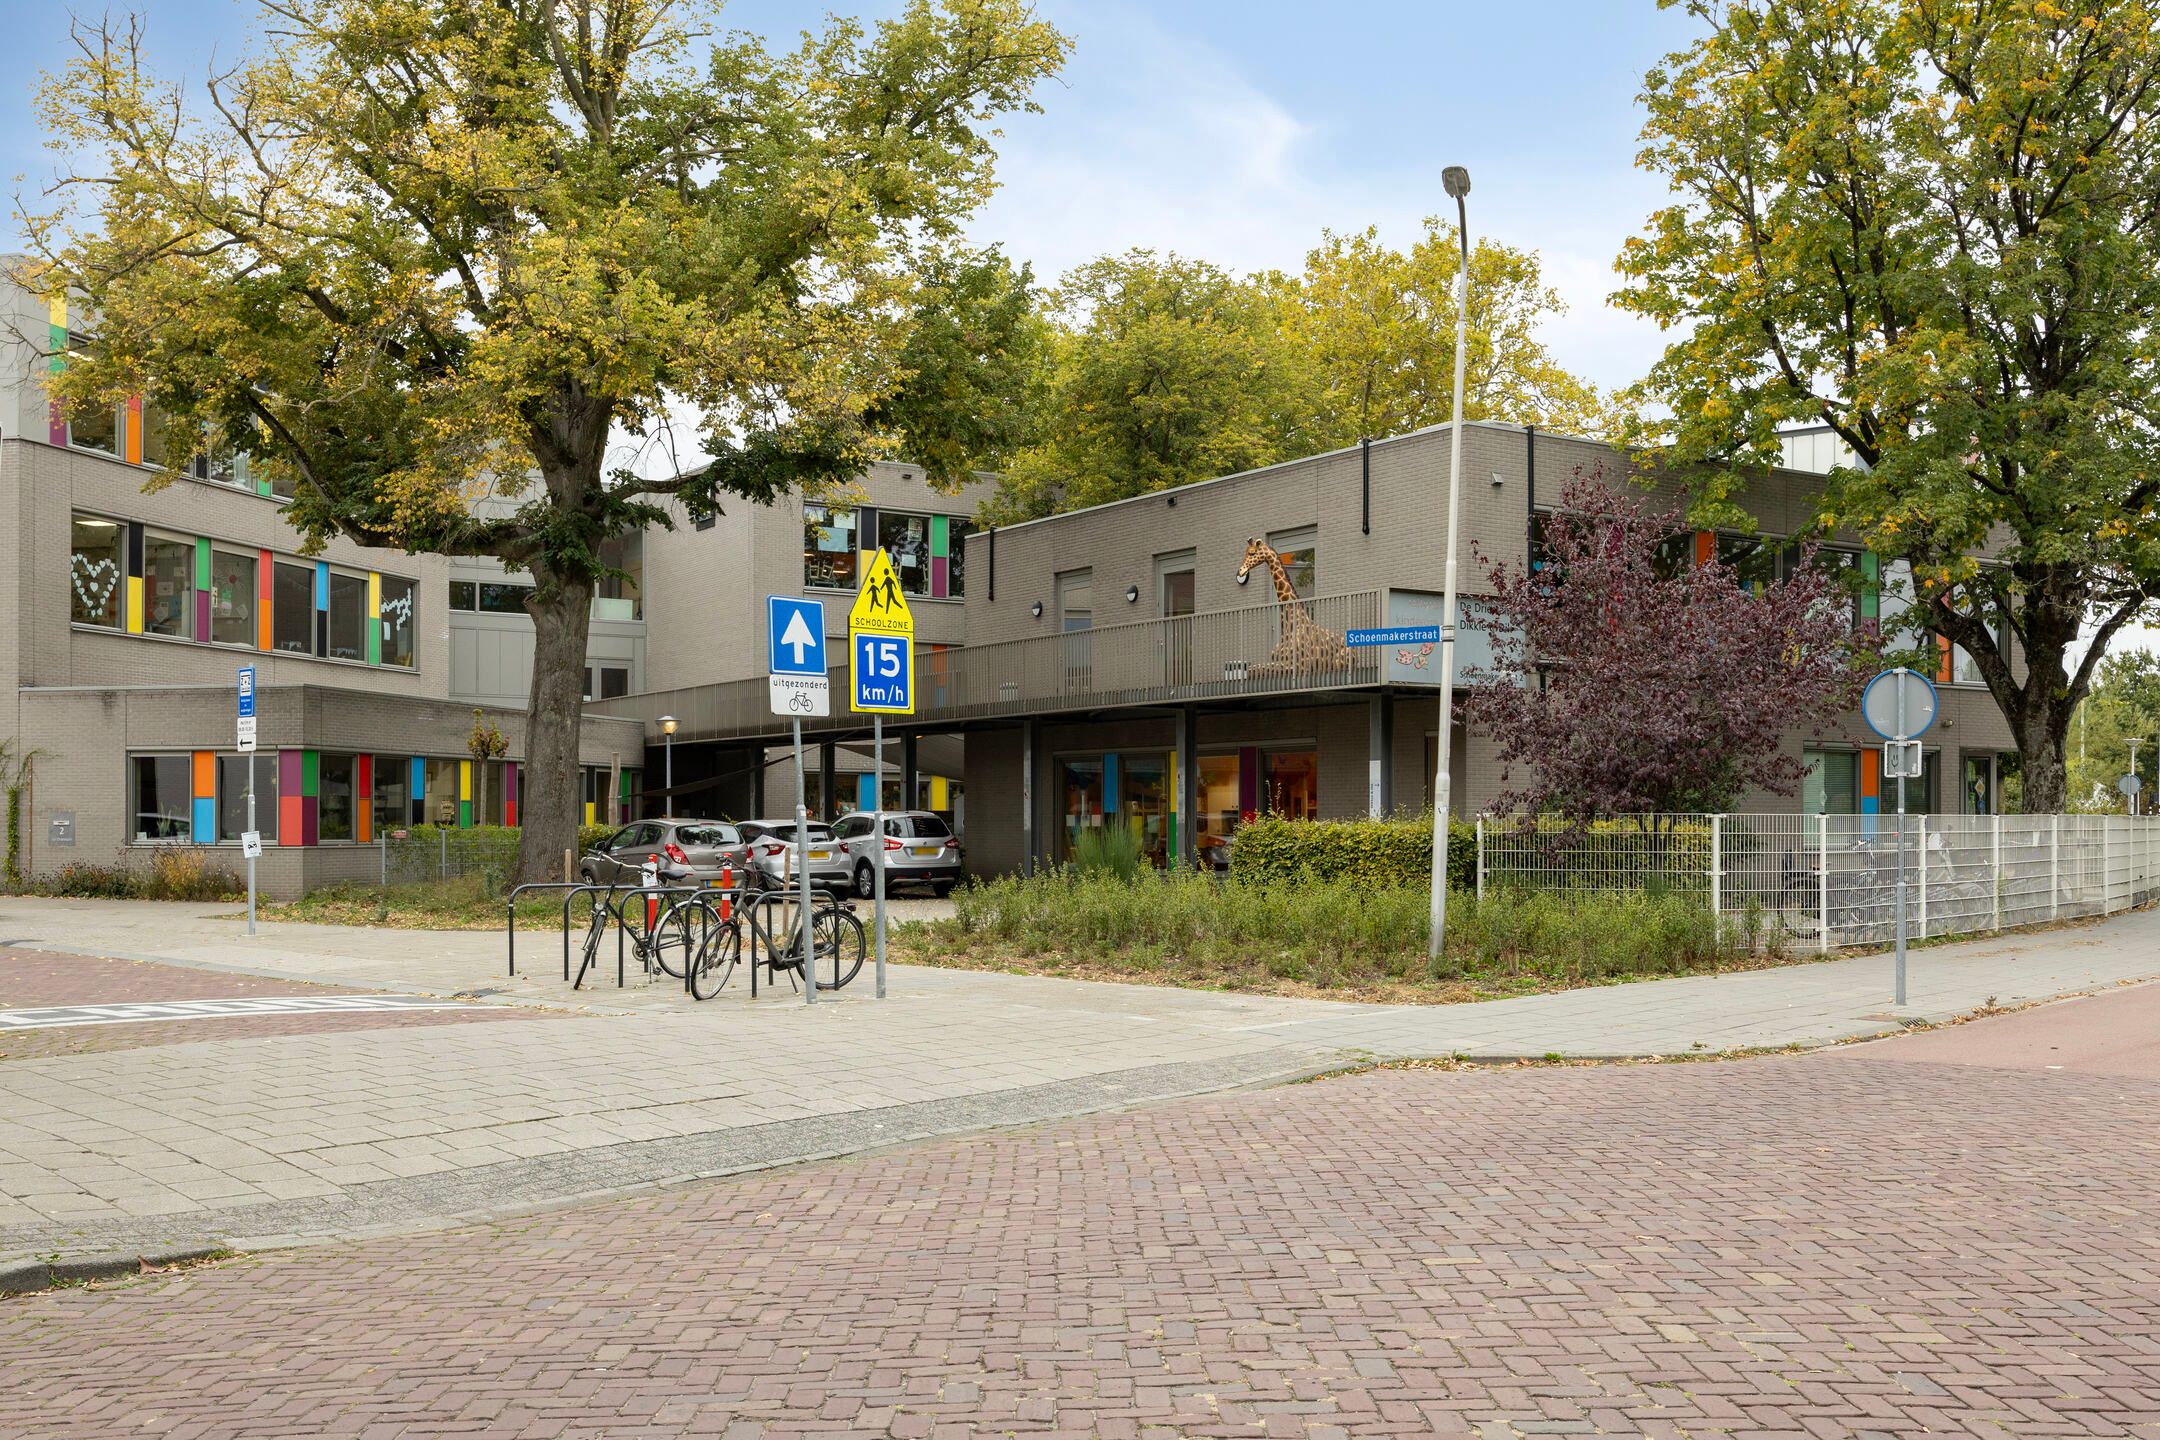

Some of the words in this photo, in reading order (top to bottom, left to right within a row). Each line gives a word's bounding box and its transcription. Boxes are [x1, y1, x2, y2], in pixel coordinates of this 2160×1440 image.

[1460, 602, 1471, 612] De
[855, 617, 909, 630] SCHOOLZONE
[1460, 620, 1487, 631] Dikkie
[1348, 629, 1438, 643] Schoenmakerstraat
[865, 641, 900, 678] 15
[1519, 674, 1524, 682] 2
[773, 679, 828, 690] uitgezonderd
[862, 684, 904, 704] km/h
[59, 827, 64, 835] 2
